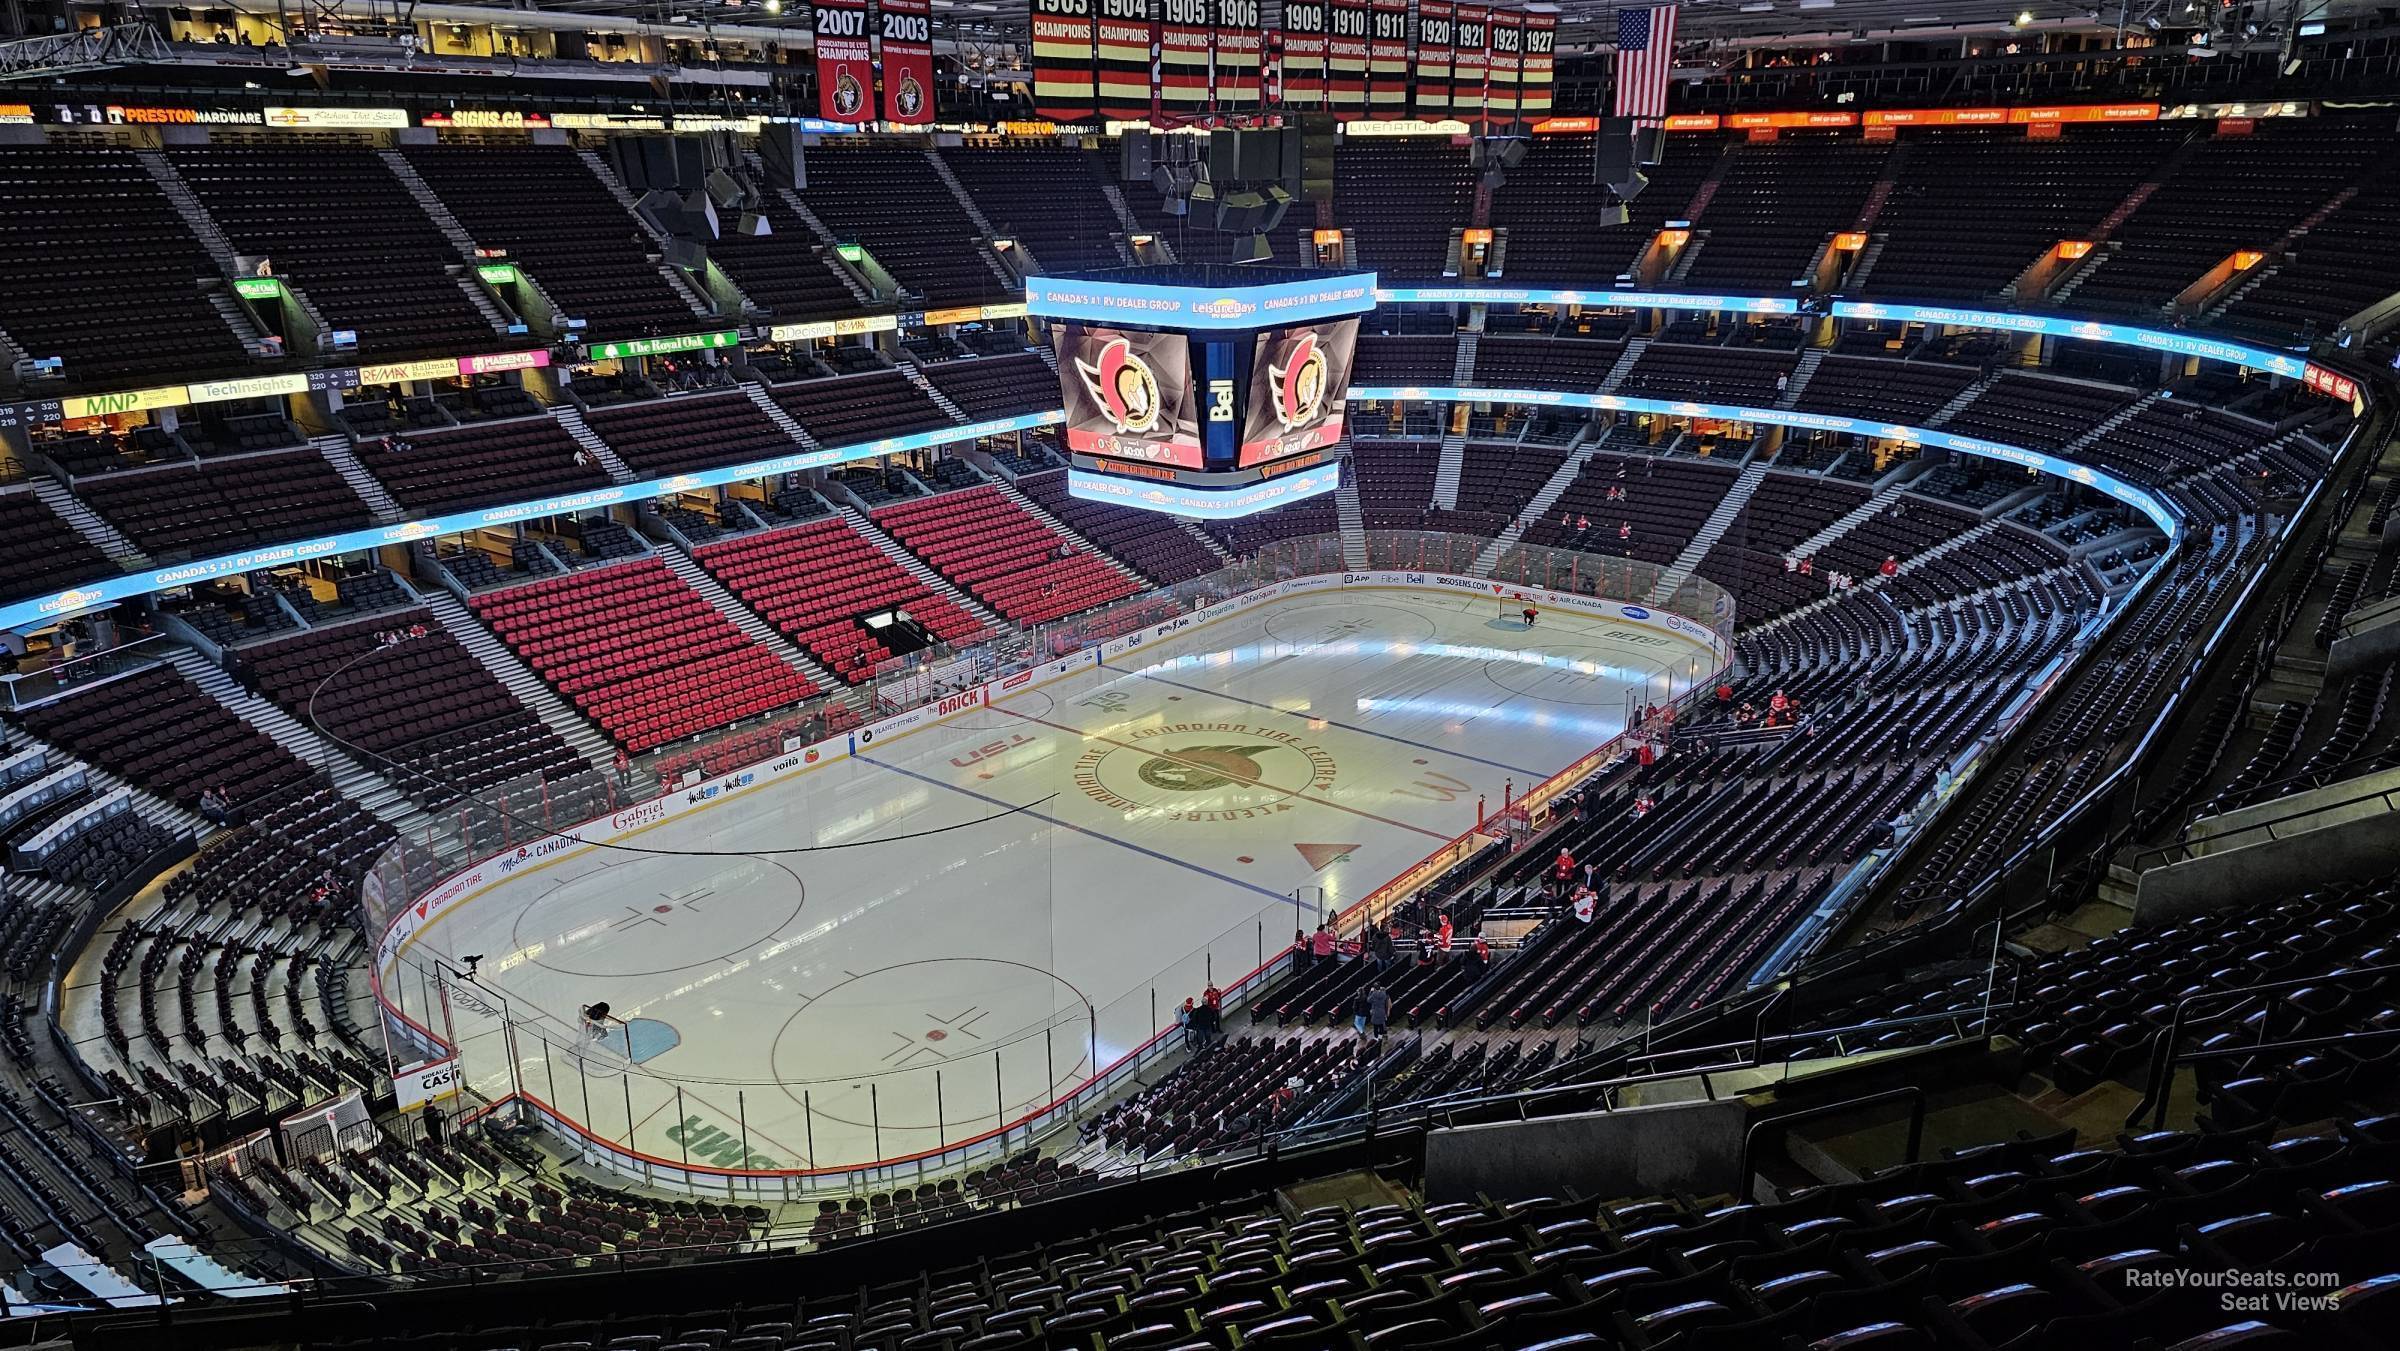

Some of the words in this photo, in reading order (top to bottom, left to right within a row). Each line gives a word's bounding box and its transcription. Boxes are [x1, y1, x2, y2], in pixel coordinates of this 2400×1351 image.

[1103, 0, 1147, 19] 1904
[1166, 0, 1206, 24] 1905
[1218, 0, 1258, 27] 1906
[1285, 4, 1322, 31] 1909
[816, 8, 865, 36] 2007
[883, 13, 929, 41] 2003
[1332, 8, 1365, 35] 1910
[1375, 12, 1405, 39] 1911
[1034, 21, 1091, 41] CHAMPIONS
[1099, 25, 1149, 45] CHAMPIONS
[1420, 19, 1450, 44] 1920
[1459, 23, 1485, 47] 1921
[817, 39, 849, 49] ASSOCIATION
[1163, 31, 1208, 49] CHAMPIONS
[1217, 34, 1260, 49] CHAMPIONS
[1284, 38, 1323, 52] CHAMPIONS
[1493, 27, 1519, 52] 1923
[1526, 30, 1554, 52] 1927
[817, 47, 870, 61] CHAMPIONS
[1330, 41, 1366, 56] CHAMPIONS
[1372, 43, 1406, 58] CHAMPIONS
[1419, 50, 1450, 62] CHAMPIONS
[1455, 52, 1485, 65] CHAMPIONS
[1490, 56, 1519, 69] CHAMPIONS
[1523, 57, 1553, 70] CHAMPIONS
[125, 108, 195, 124] PRESTON
[194, 110, 263, 124] HARDWARE
[451, 110, 524, 128] SIGNS.CA
[1006, 121, 1055, 135] PRESTON
[1054, 124, 1100, 136] HARDWARE
[1349, 122, 1469, 133] LIVENATION.com
[1047, 292, 1089, 305] CANADA'S
[1091, 296, 1101, 305] #1
[1103, 297, 1115, 307] RV
[1117, 298, 1148, 309] DEALER
[1149, 300, 1181, 312] GROUP
[1264, 296, 1298, 311] CANADA'S
[1309, 295, 1318, 304] RV
[1319, 290, 1341, 302] DEALER
[1342, 287, 1365, 299] GROUP
[1192, 301, 1257, 315] LeisureDays
[1843, 305, 1888, 316] LeisureDays
[1914, 310, 1957, 320] CANADA'S
[1971, 314, 1983, 322] RV
[1985, 315, 2017, 325] DEALER
[2018, 319, 2047, 329] GROUP
[786, 326, 832, 340] Decisive
[2070, 325, 2113, 337] LeisureDays
[627, 341, 649, 353] The
[651, 337, 682, 354] Royal
[683, 335, 705, 348] Oak
[2136, 333, 2174, 348] CANADA'S
[2186, 342, 2197, 352] RV
[2198, 343, 2226, 358] DEALER
[2226, 348, 2247, 361] GROUP
[411, 360, 456, 372] Hallmark
[484, 353, 535, 367] MAGENTA
[2264, 357, 2297, 373] LeisureDays
[344, 369, 357, 377] 321
[362, 365, 410, 383] RE/MAX
[203, 378, 294, 397] TechInsights
[311, 382, 327, 390] 220
[345, 379, 358, 387] 221
[41, 402, 59, 411] 320
[87, 393, 138, 415] MNP
[1209, 380, 1234, 422] Bell
[0, 407, 14, 416] 319
[43, 412, 61, 422] 220
[1739, 410, 1777, 420] CANADA'S
[1787, 415, 1797, 423] RV
[1799, 417, 1825, 425] DEALER
[1826, 419, 1853, 428] GROUP
[1, 418, 17, 427] 219
[1098, 439, 1105, 449] 0
[1123, 446, 1145, 458] 60:00
[1284, 442, 1301, 454] 60:00
[1948, 438, 1981, 451] CANADA'S
[1992, 446, 2002, 455] RV
[2002, 448, 2025, 460] DEALER
[2025, 454, 2046, 466] GROUP
[1164, 447, 1171, 458] 0
[734, 465, 771, 477] CANADA'S
[783, 460, 793, 468] RV
[794, 455, 818, 465] DEALER
[818, 451, 843, 461] GROUP
[1084, 480, 1108, 492] DEALER
[1108, 484, 1133, 497] GROUP
[1180, 497, 1221, 509] CANADA'S
[1265, 486, 1286, 498] GROUP
[482, 507, 531, 522] CANADA'S
[546, 501, 559, 510] RV
[560, 496, 592, 508] DEALER
[593, 490, 624, 502] GROUP
[383, 524, 440, 540] LeisureDays
[155, 564, 217, 584] CANADA'S
[221, 561, 233, 571] #1
[237, 557, 252, 568] RV
[255, 549, 295, 563] DEALER
[296, 541, 337, 556] GROUP
[1381, 574, 1399, 583] Fibe
[1406, 574, 1425, 584] Bell
[39, 590, 103, 613] LeisureDays
[1249, 588, 1277, 603] FairSquare
[1558, 596, 1571, 604] AIR
[1571, 597, 1602, 609] CANADA
[1206, 603, 1235, 618] Desjardins
[1681, 621, 1707, 639] Supreme
[1128, 632, 1142, 648] Bell
[1604, 631, 1671, 646] BET99
[926, 706, 938, 716] The
[938, 689, 978, 716] BRICK
[874, 722, 897, 735] PLANET
[897, 714, 920, 728] FITNESS
[1080, 748, 1108, 769] TIRE
[1130, 723, 1248, 739] CANADIAN
[1255, 727, 1303, 744] TIRE
[1302, 745, 1337, 783] CENTRE
[772, 756, 799, 772] voilà
[612, 800, 664, 831] Gabriel
[629, 812, 666, 828] PIZZA
[1169, 806, 1273, 822] CENTRE
[499, 850, 536, 872] Molson
[536, 832, 581, 857] CANADIAN
[431, 882, 465, 909] CANADIAN
[465, 872, 483, 888] TIRE
[421, 1068, 444, 1080] RIDEAU
